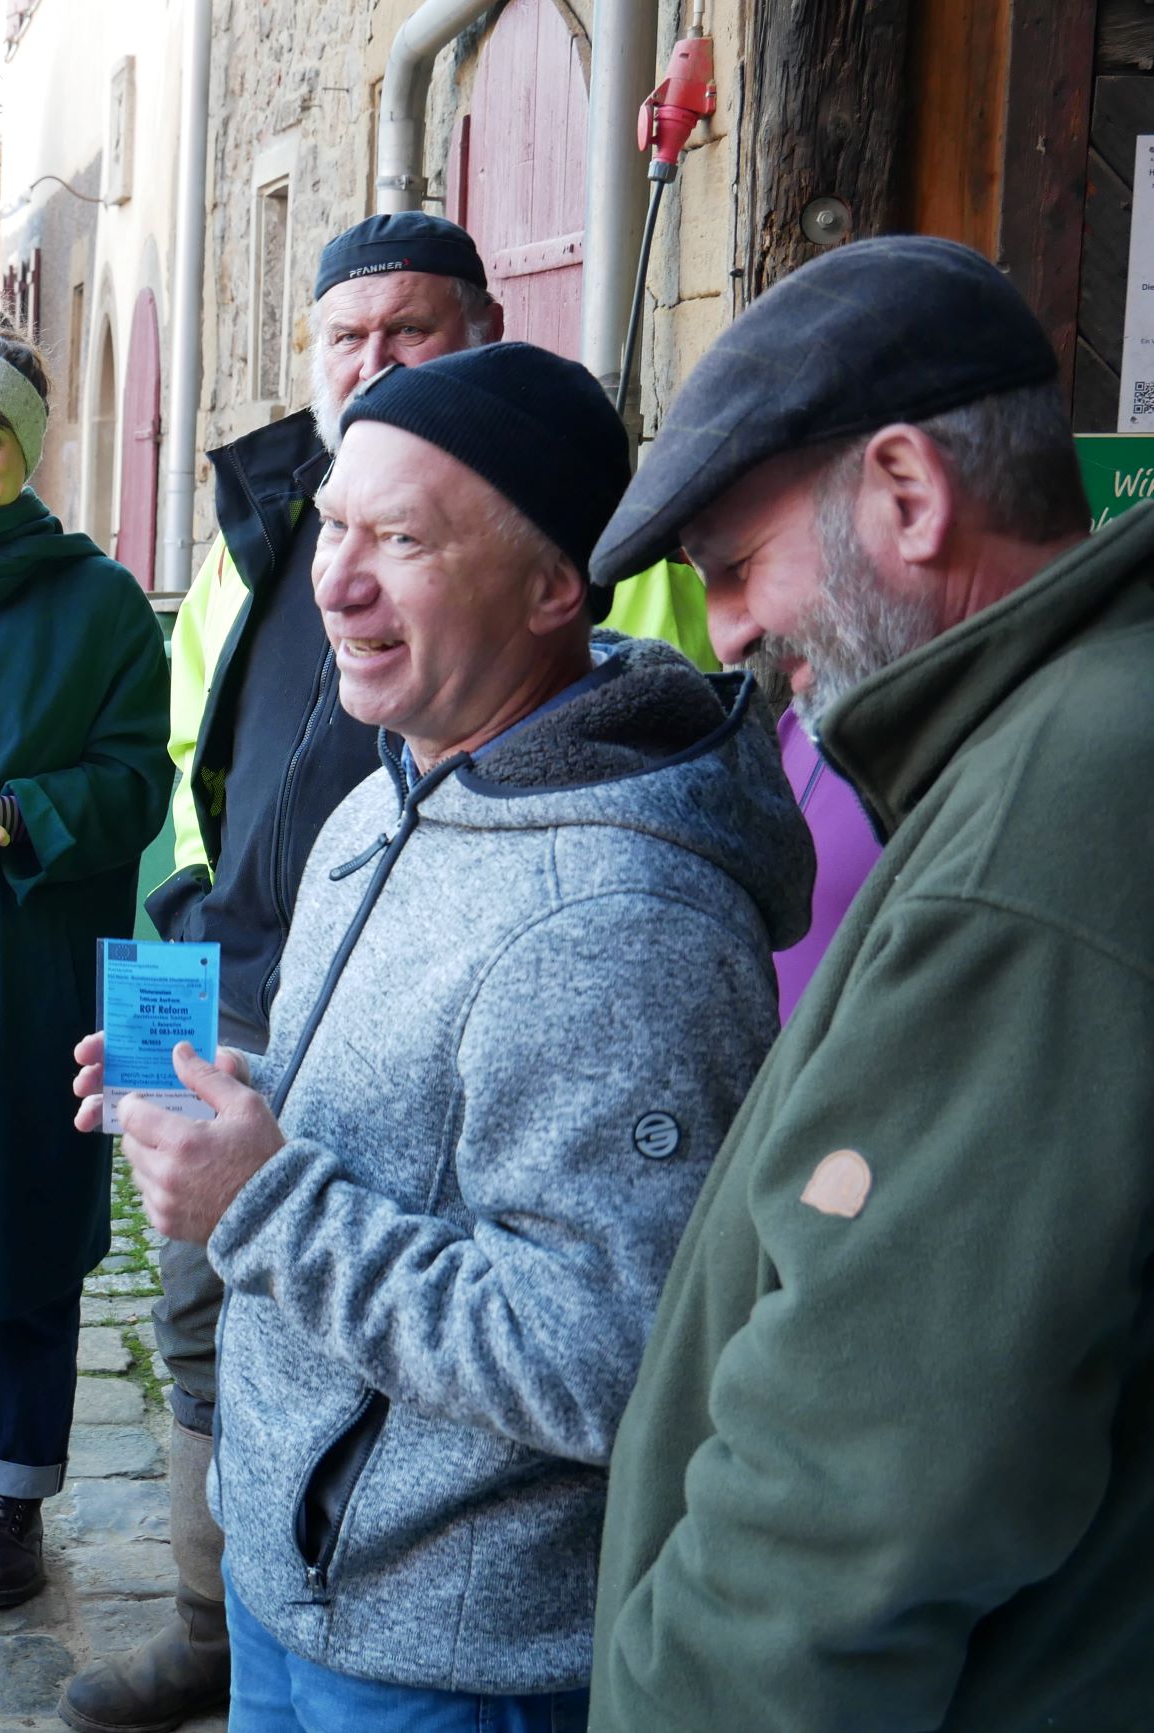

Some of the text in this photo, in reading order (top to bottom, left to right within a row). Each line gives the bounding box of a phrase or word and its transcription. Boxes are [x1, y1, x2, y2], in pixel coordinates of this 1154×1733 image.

[349, 261, 403, 278] PFANNER
[139, 1005, 188, 1015] RGT Reform
